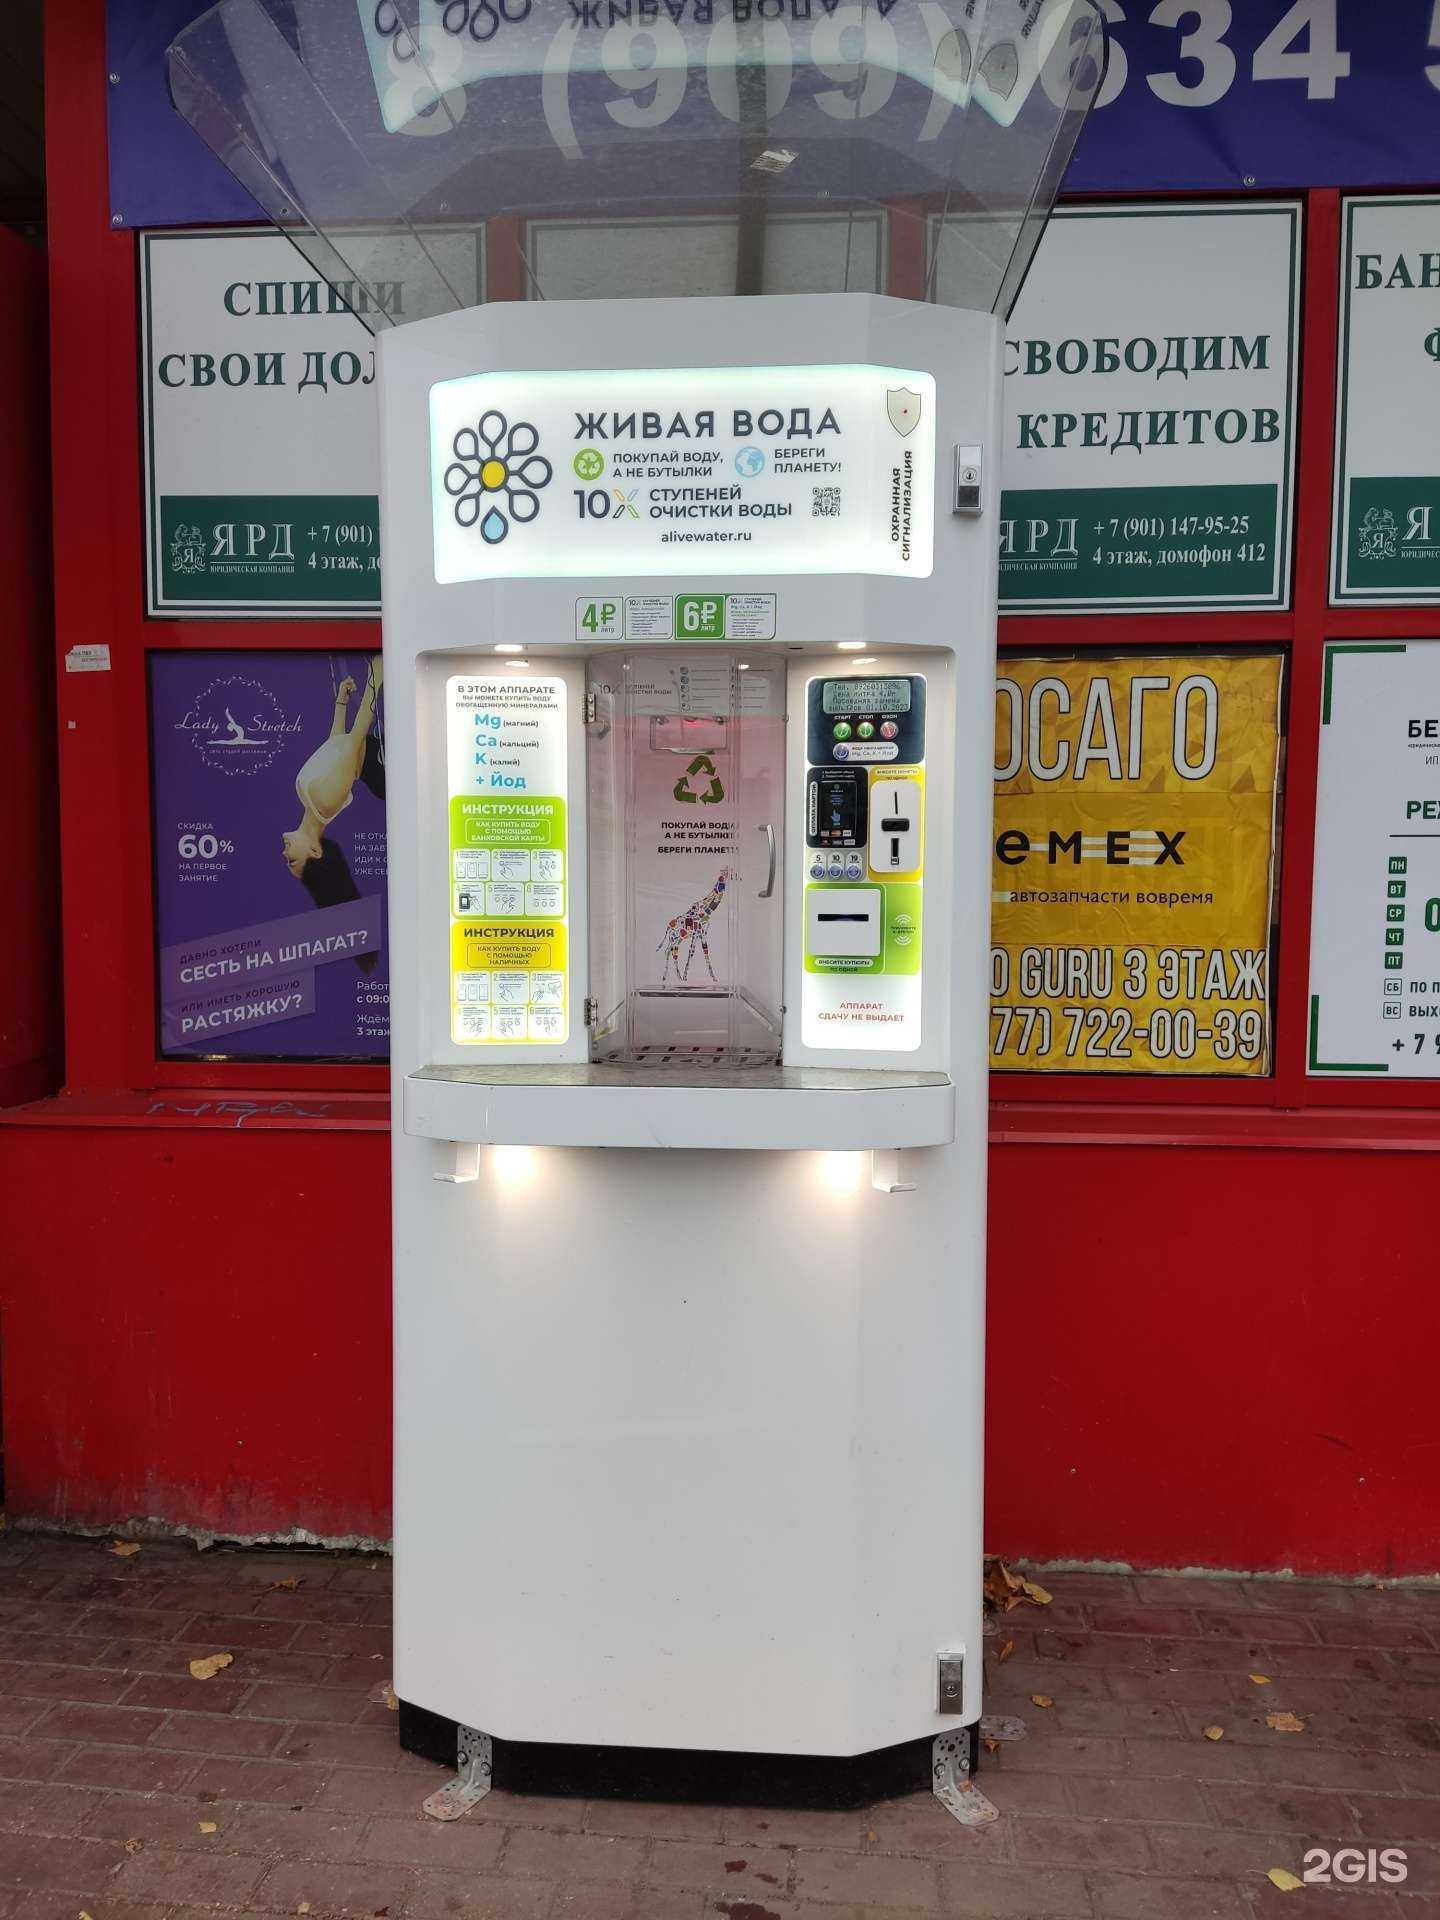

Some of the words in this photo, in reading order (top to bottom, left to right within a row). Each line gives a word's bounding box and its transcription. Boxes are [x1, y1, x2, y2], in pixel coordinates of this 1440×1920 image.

[1038, 0, 1350, 111] 634
[224, 280, 405, 317] СПИШИ
[158, 352, 286, 387] СВОИ
[574, 411, 715, 439] ЖИВАЯ
[733, 407, 841, 439] ВОДА
[1016, 408, 1280, 455] КРЕДИТОВ
[613, 451, 679, 464] ПОКУПАЙ
[683, 451, 724, 464] ВОДУ,
[774, 448, 825, 459] БЕРЕГИ
[613, 468, 622, 478] А
[626, 468, 644, 478] НЕ
[647, 467, 713, 478] БУТЫЛКИ
[774, 462, 841, 473] ПЛАНЕТУ!
[650, 484, 742, 502] СТУПЕНЕЙ
[650, 504, 733, 519] ОЧИСТКИ
[738, 503, 792, 518] ВОДЫ
[891, 467, 901, 541] ОХРАННАЯ
[902, 450, 913, 561] СИГНАЛИЗАЦИЯ
[307, 528, 317, 540] +
[322, 525, 330, 543] 7
[335, 525, 373, 547] (901)
[1093, 523, 1105, 537] +
[1110, 518, 1119, 537] 7
[1123, 518, 1165, 541] (901)
[1170, 515, 1249, 536] 147-95-25
[210, 523, 295, 560] ЯРД
[661, 531, 752, 543] alivewater.ru
[308, 552, 317, 569] 4
[321, 554, 363, 572] этаж,
[1092, 548, 1102, 565] 4
[1108, 551, 1152, 567] этаж,
[1157, 545, 1232, 567] домофон
[1237, 543, 1266, 562] 412
[499, 686, 555, 694] АППАРАТЕ
[174, 711, 219, 734] Lady
[247, 714, 303, 732] Stretch
[475, 714, 501, 729] Mg
[994, 675, 1218, 781] ОСАГО
[475, 734, 497, 746] Ca
[499, 740, 540, 748] (кальций)
[475, 753, 487, 764] K
[490, 758, 520, 766] (калий)
[1425, 755, 1439, 765] ИП
[491, 771, 527, 788] Йод
[462, 804, 554, 816] ИНСТРУКЦИЯ
[1406, 800, 1440, 819] РЕ
[177, 822, 214, 831] СКИДКА
[661, 821, 706, 829] ПОКУПАЙ
[354, 832, 366, 840] НЕ
[178, 834, 234, 859] 60%
[1390, 861, 1405, 870] ПН
[1390, 885, 1403, 894] ВТ
[1009, 890, 1130, 903] автозапчасти
[1136, 891, 1213, 908] вовремя
[1389, 909, 1402, 917] СР
[464, 928, 554, 938] ИНСТРУКЦИЯ
[1388, 932, 1402, 941] ЧТ
[180, 949, 217, 964] ДАВНО
[220, 940, 261, 955] ХОТЕЛИ
[180, 958, 241, 983] СЕСТЬ
[246, 951, 274, 970] НА
[279, 930, 369, 963] ШПАГАТ?
[1388, 956, 1401, 965] ПТ
[1019, 946, 1113, 998] GURU
[1123, 948, 1147, 999] 3
[1157, 948, 1266, 1000] ЭТАЖ
[1386, 983, 1399, 991] СБ
[1410, 982, 1427, 993] ПО
[181, 1001, 203, 1013] ИЛИ
[207, 994, 242, 1008] ИМЕТЬ
[245, 980, 300, 1000] ХОРОШУЮ
[181, 994, 303, 1033] РАСТЯЖКУ?
[840, 1002, 883, 1010] АППАРАТ
[1386, 1006, 1399, 1015] ВС
[818, 1013, 849, 1021] СДАЧУ
[866, 1014, 904, 1022] ВЫДАЕТ
[357, 1027, 363, 1036] 3
[1062, 1006, 1263, 1060] 722-00-39
[1392, 1039, 1405, 1051] +
[1414, 1033, 1425, 1055] 7
